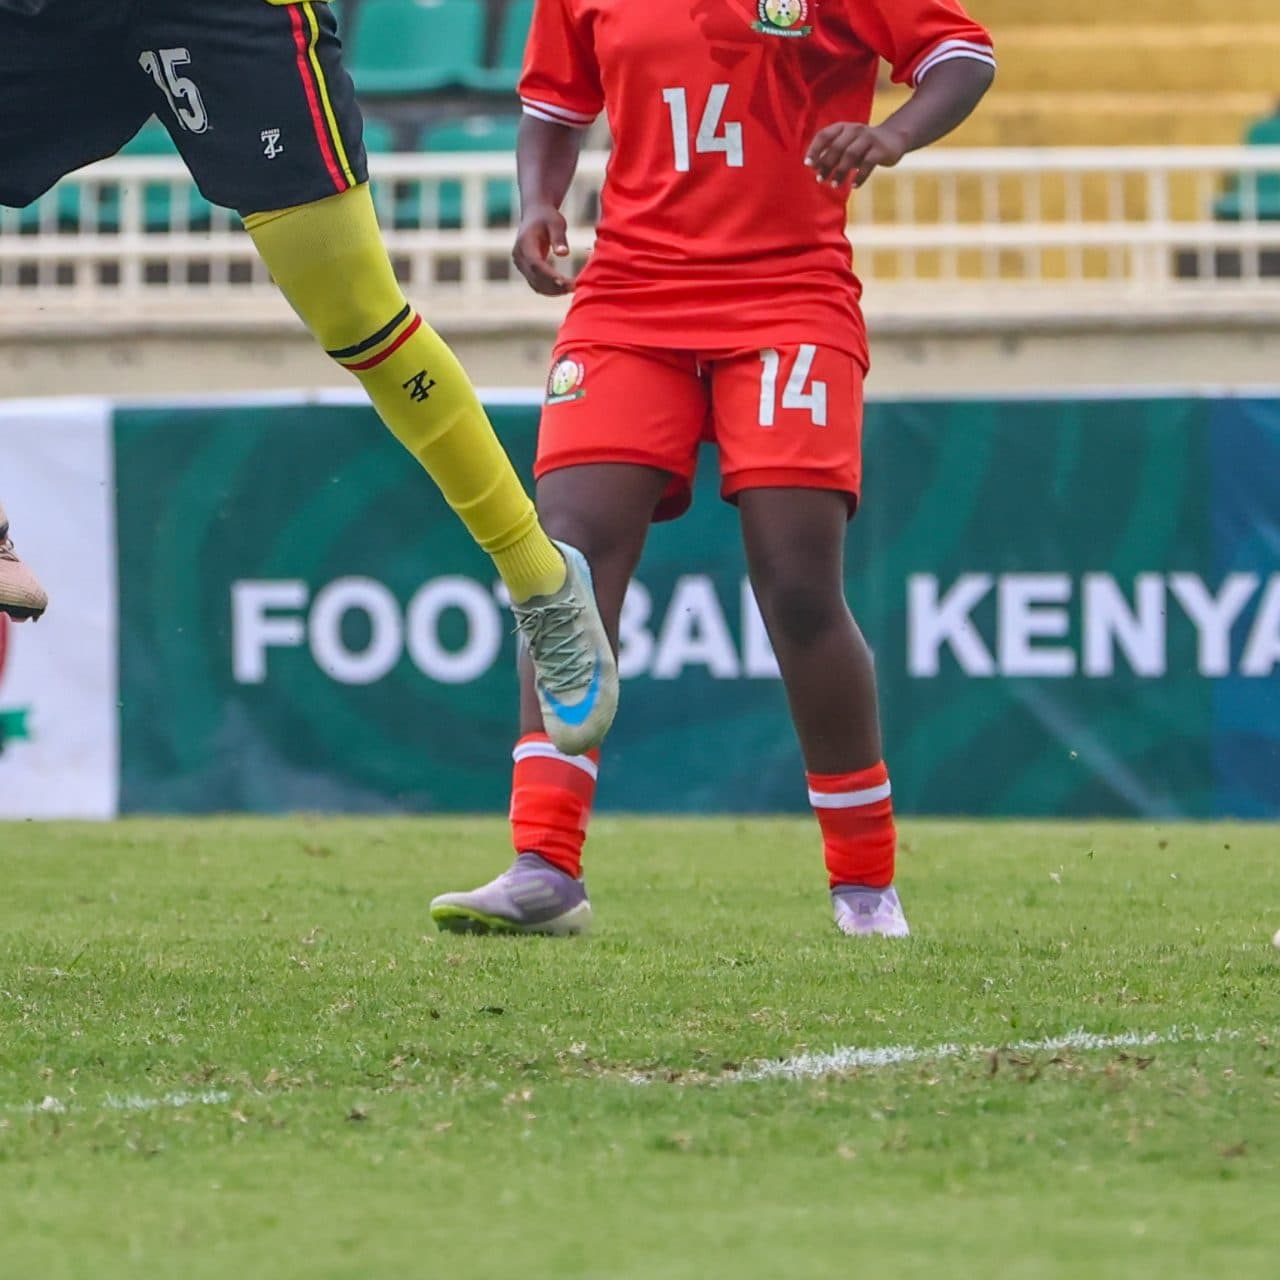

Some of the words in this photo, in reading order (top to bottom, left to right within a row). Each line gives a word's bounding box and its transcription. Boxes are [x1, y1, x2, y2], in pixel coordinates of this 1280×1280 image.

[138, 47, 208, 134] 15
[662, 83, 744, 172] 14
[759, 343, 827, 427] 14
